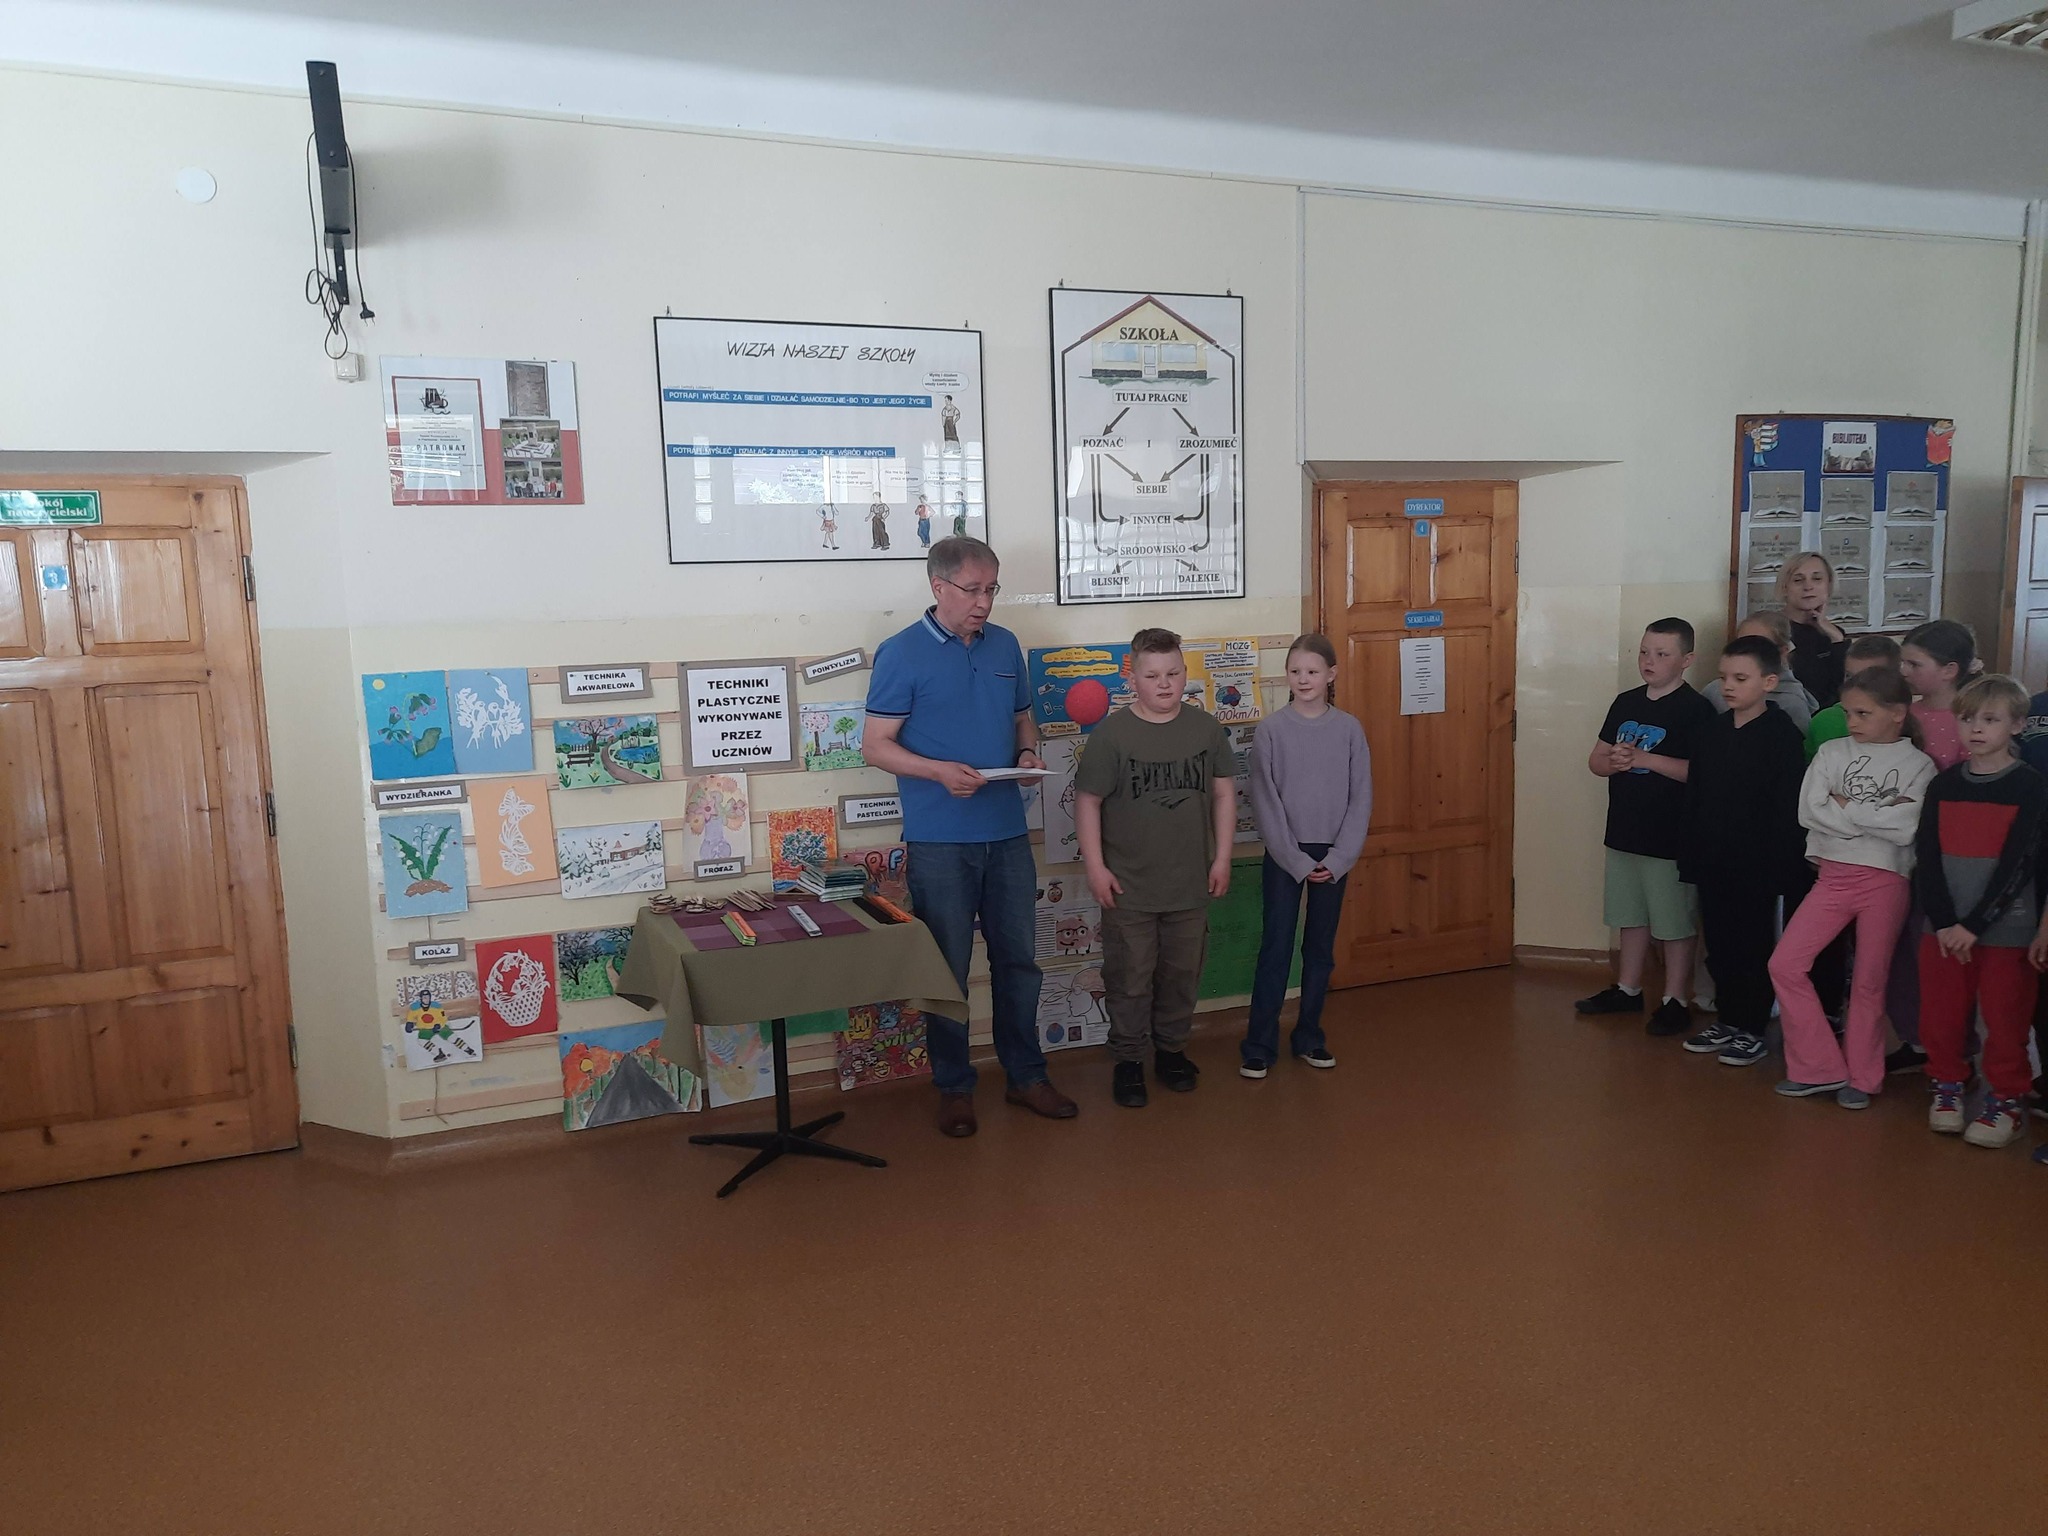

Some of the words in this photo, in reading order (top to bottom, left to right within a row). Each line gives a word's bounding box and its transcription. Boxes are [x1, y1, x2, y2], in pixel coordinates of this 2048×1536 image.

[1119, 327, 1179, 341] SZKOŁA
[727, 341, 775, 357] WIZJA
[783, 344, 849, 360] NASZEJ
[857, 347, 917, 364] SZKOŁY
[669, 392, 699, 400] POTRAFI
[702, 391, 730, 400] MYŚLEĆ
[771, 394, 799, 402] DZIAŁAĆ
[872, 397, 887, 405] JEST
[889, 397, 906, 405] JEGO
[909, 396, 926, 405] ŻYCIE
[1115, 392, 1146, 403] TUTAJ
[1082, 437, 1124, 448] POZNAĆ
[1147, 439, 1151, 448] I
[1179, 437, 1238, 449] ZROZUMIEĆ
[1832, 432, 1867, 444] BIBLIOTEKA
[837, 448, 861, 457] WŚRÓD
[863, 449, 888, 457] INNYCH
[1136, 485, 1168, 494] SIEBIE
[38, 498, 63, 509] okój
[1407, 503, 1441, 511] DYREKTOR
[7, 508, 87, 518] naucycielski
[1133, 515, 1172, 525] INNYCH
[1091, 576, 1130, 587] BLISKIE
[1178, 573, 1220, 583] DALEKIE
[812, 657, 857, 675] POINTYLIZM
[583, 672, 627, 681] TECHNIKA
[576, 682, 635, 692] AKWARELOWA
[707, 678, 769, 690] TECHNIKI
[697, 694, 781, 708] PLASTYCZNE
[697, 711, 783, 723] WYKONYWANE
[721, 730, 762, 741] PRZEZ
[711, 744, 773, 758] UCZNIÓW
[1129, 749, 1208, 799] EVERLAST
[386, 789, 452, 801] WYDZIERANKA
[859, 800, 896, 809] TECHNIKA
[856, 809, 899, 818] PASTELOWA
